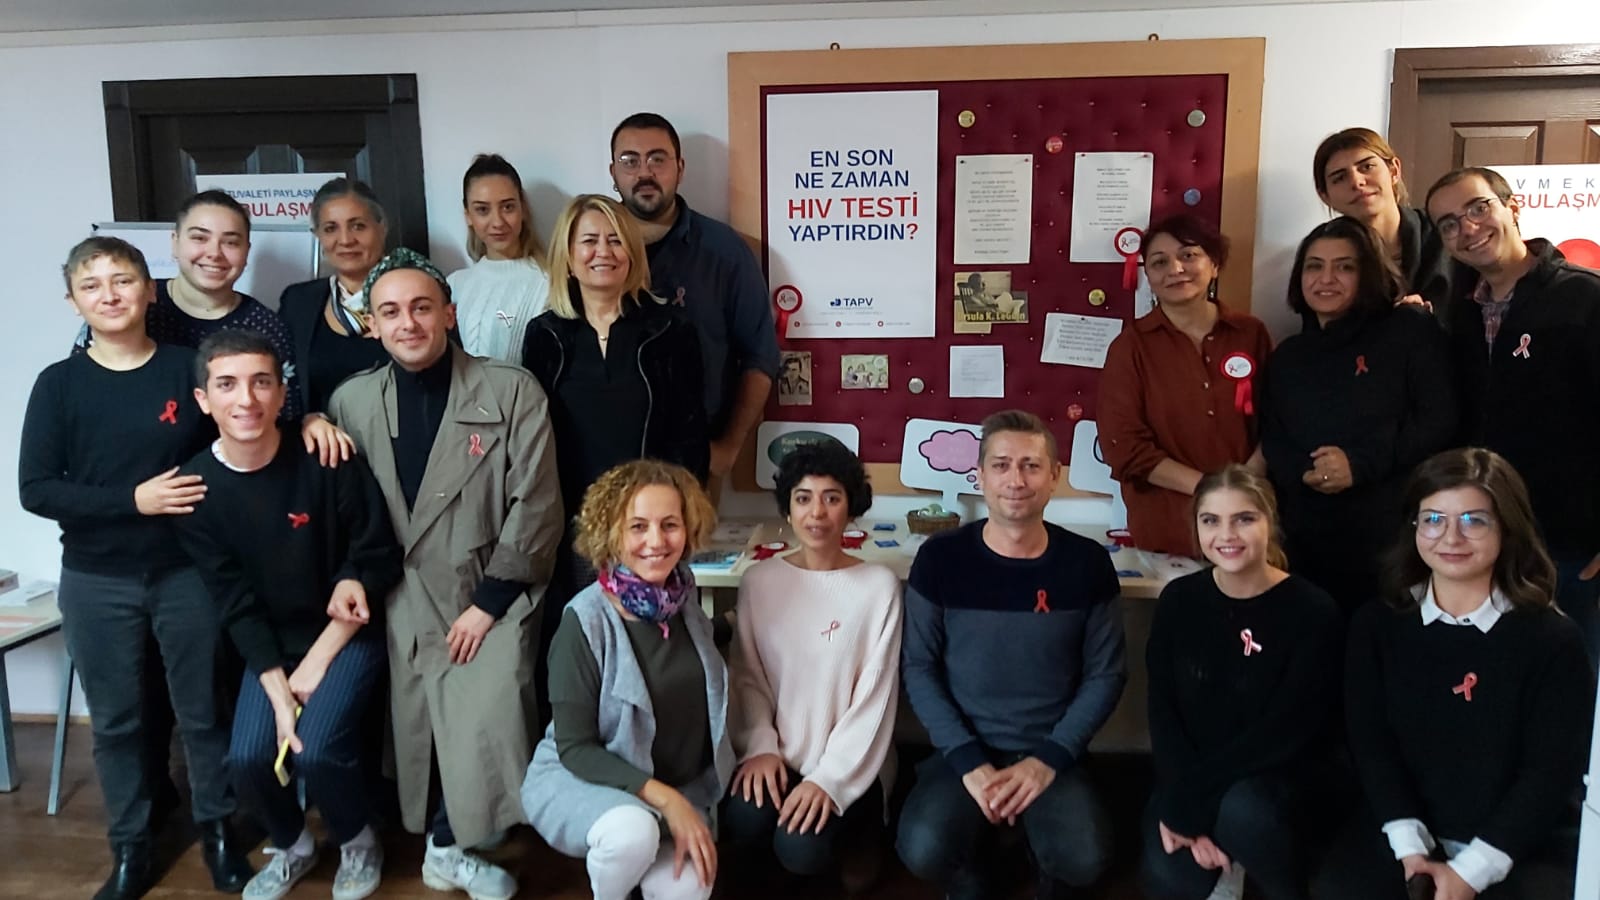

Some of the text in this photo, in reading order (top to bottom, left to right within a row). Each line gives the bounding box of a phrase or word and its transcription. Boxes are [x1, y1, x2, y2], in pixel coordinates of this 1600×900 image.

[810, 149, 893, 167] EN SON
[795, 170, 909, 189] NE ZAMAN
[788, 192, 918, 219] HIV TESTİ
[789, 223, 919, 242] YAPTIRDIN?
[843, 297, 873, 306] TAPV
